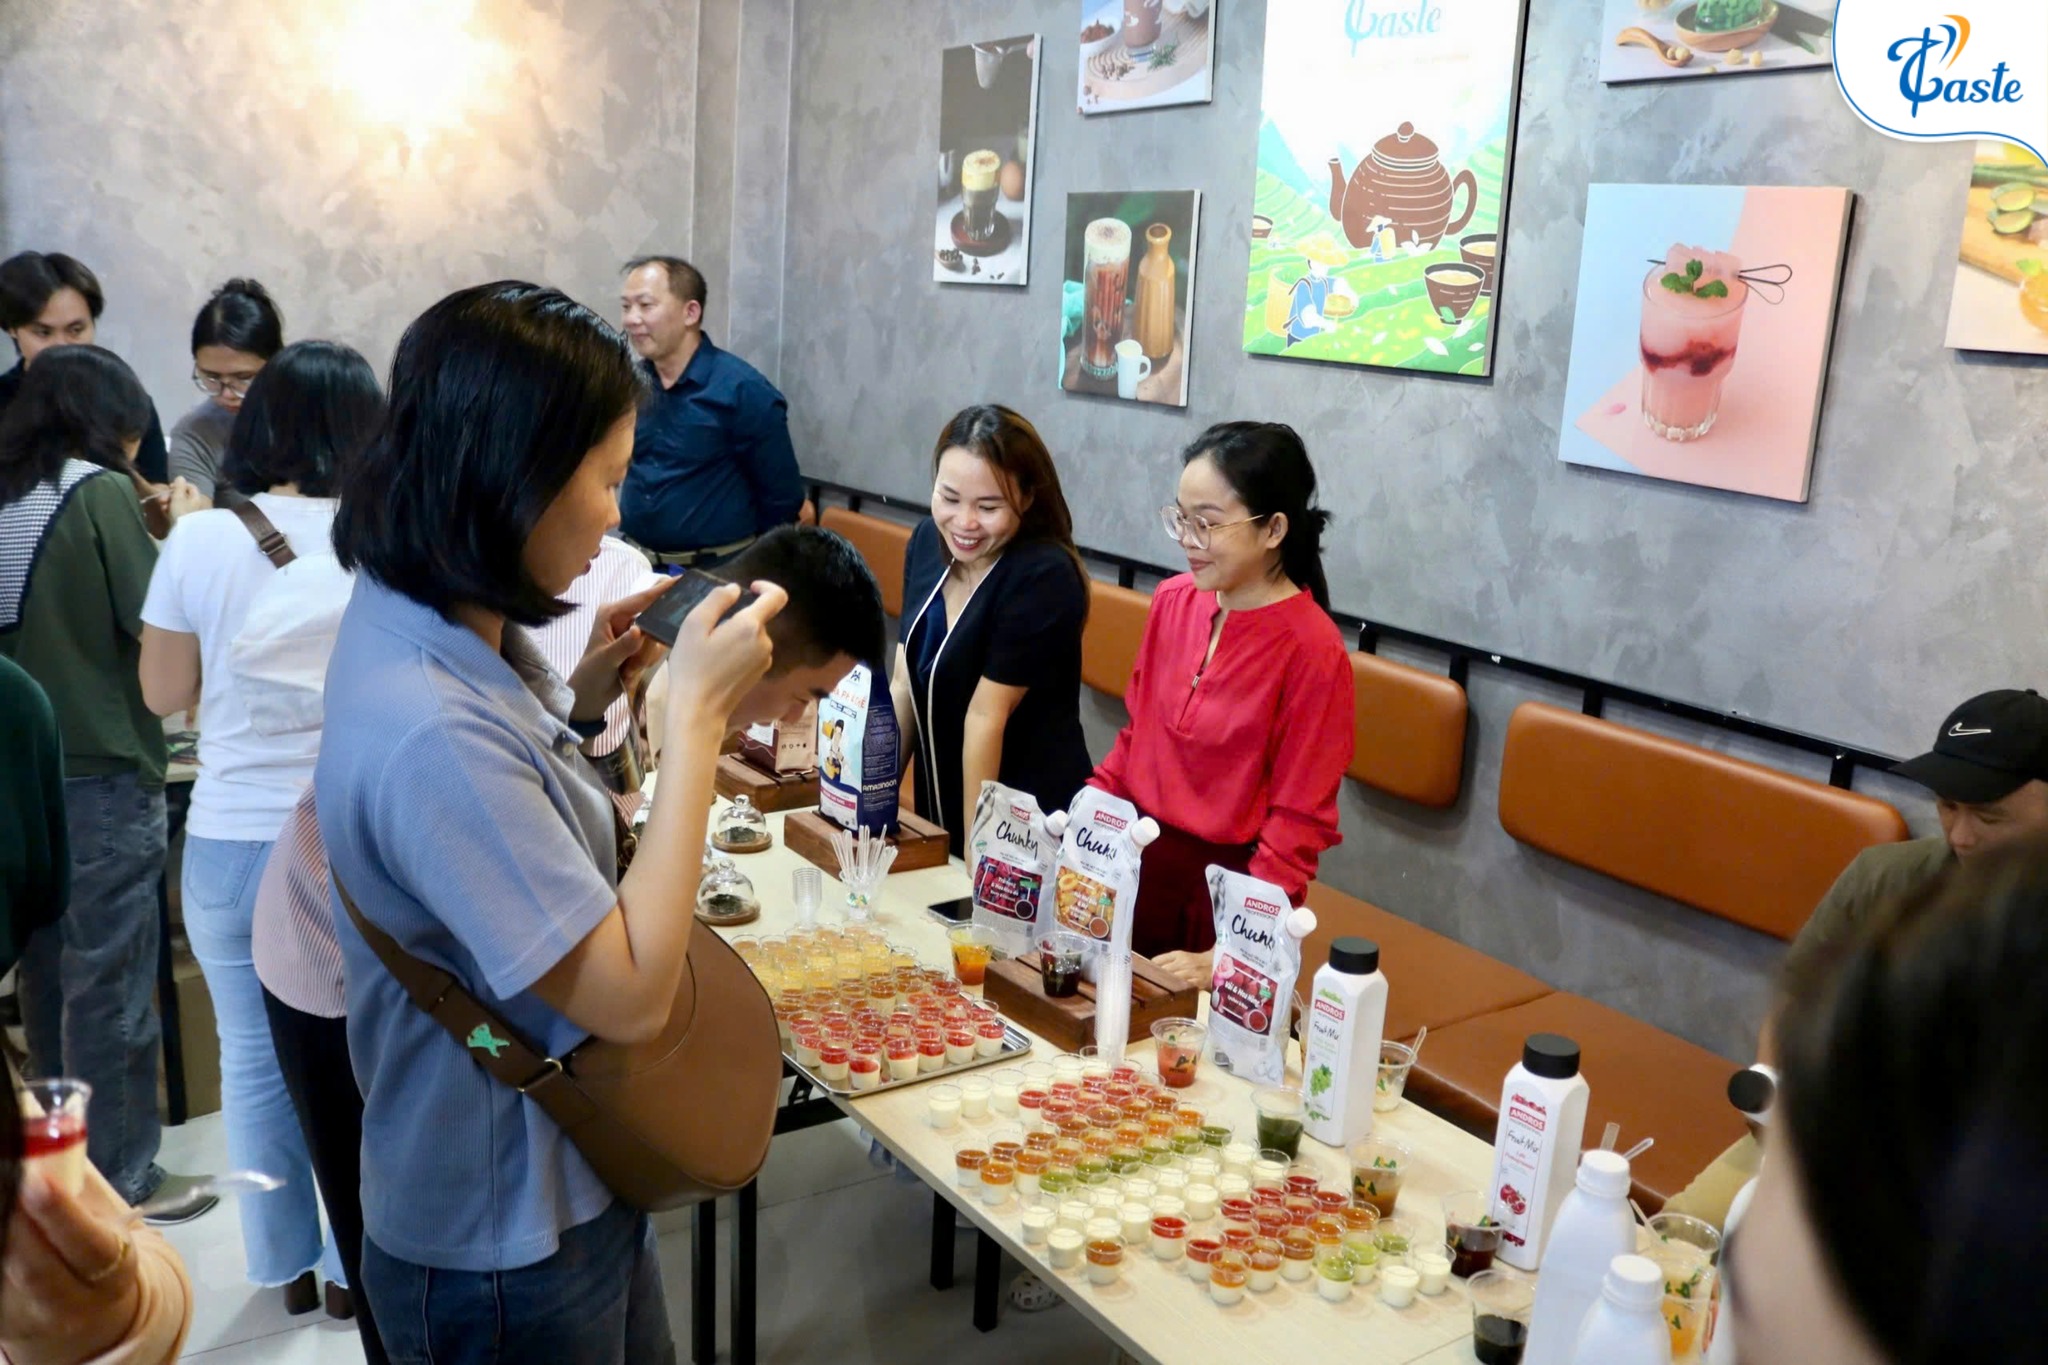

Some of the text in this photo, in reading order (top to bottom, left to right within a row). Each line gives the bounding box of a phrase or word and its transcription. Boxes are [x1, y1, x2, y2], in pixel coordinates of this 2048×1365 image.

[1095, 811, 1127, 830] ANDROS
[996, 820, 1038, 861] Chunky
[1245, 898, 1280, 916] ANDROS
[1315, 1000, 1344, 1020] ANDROS
[1510, 1108, 1544, 1131] ANDROS
